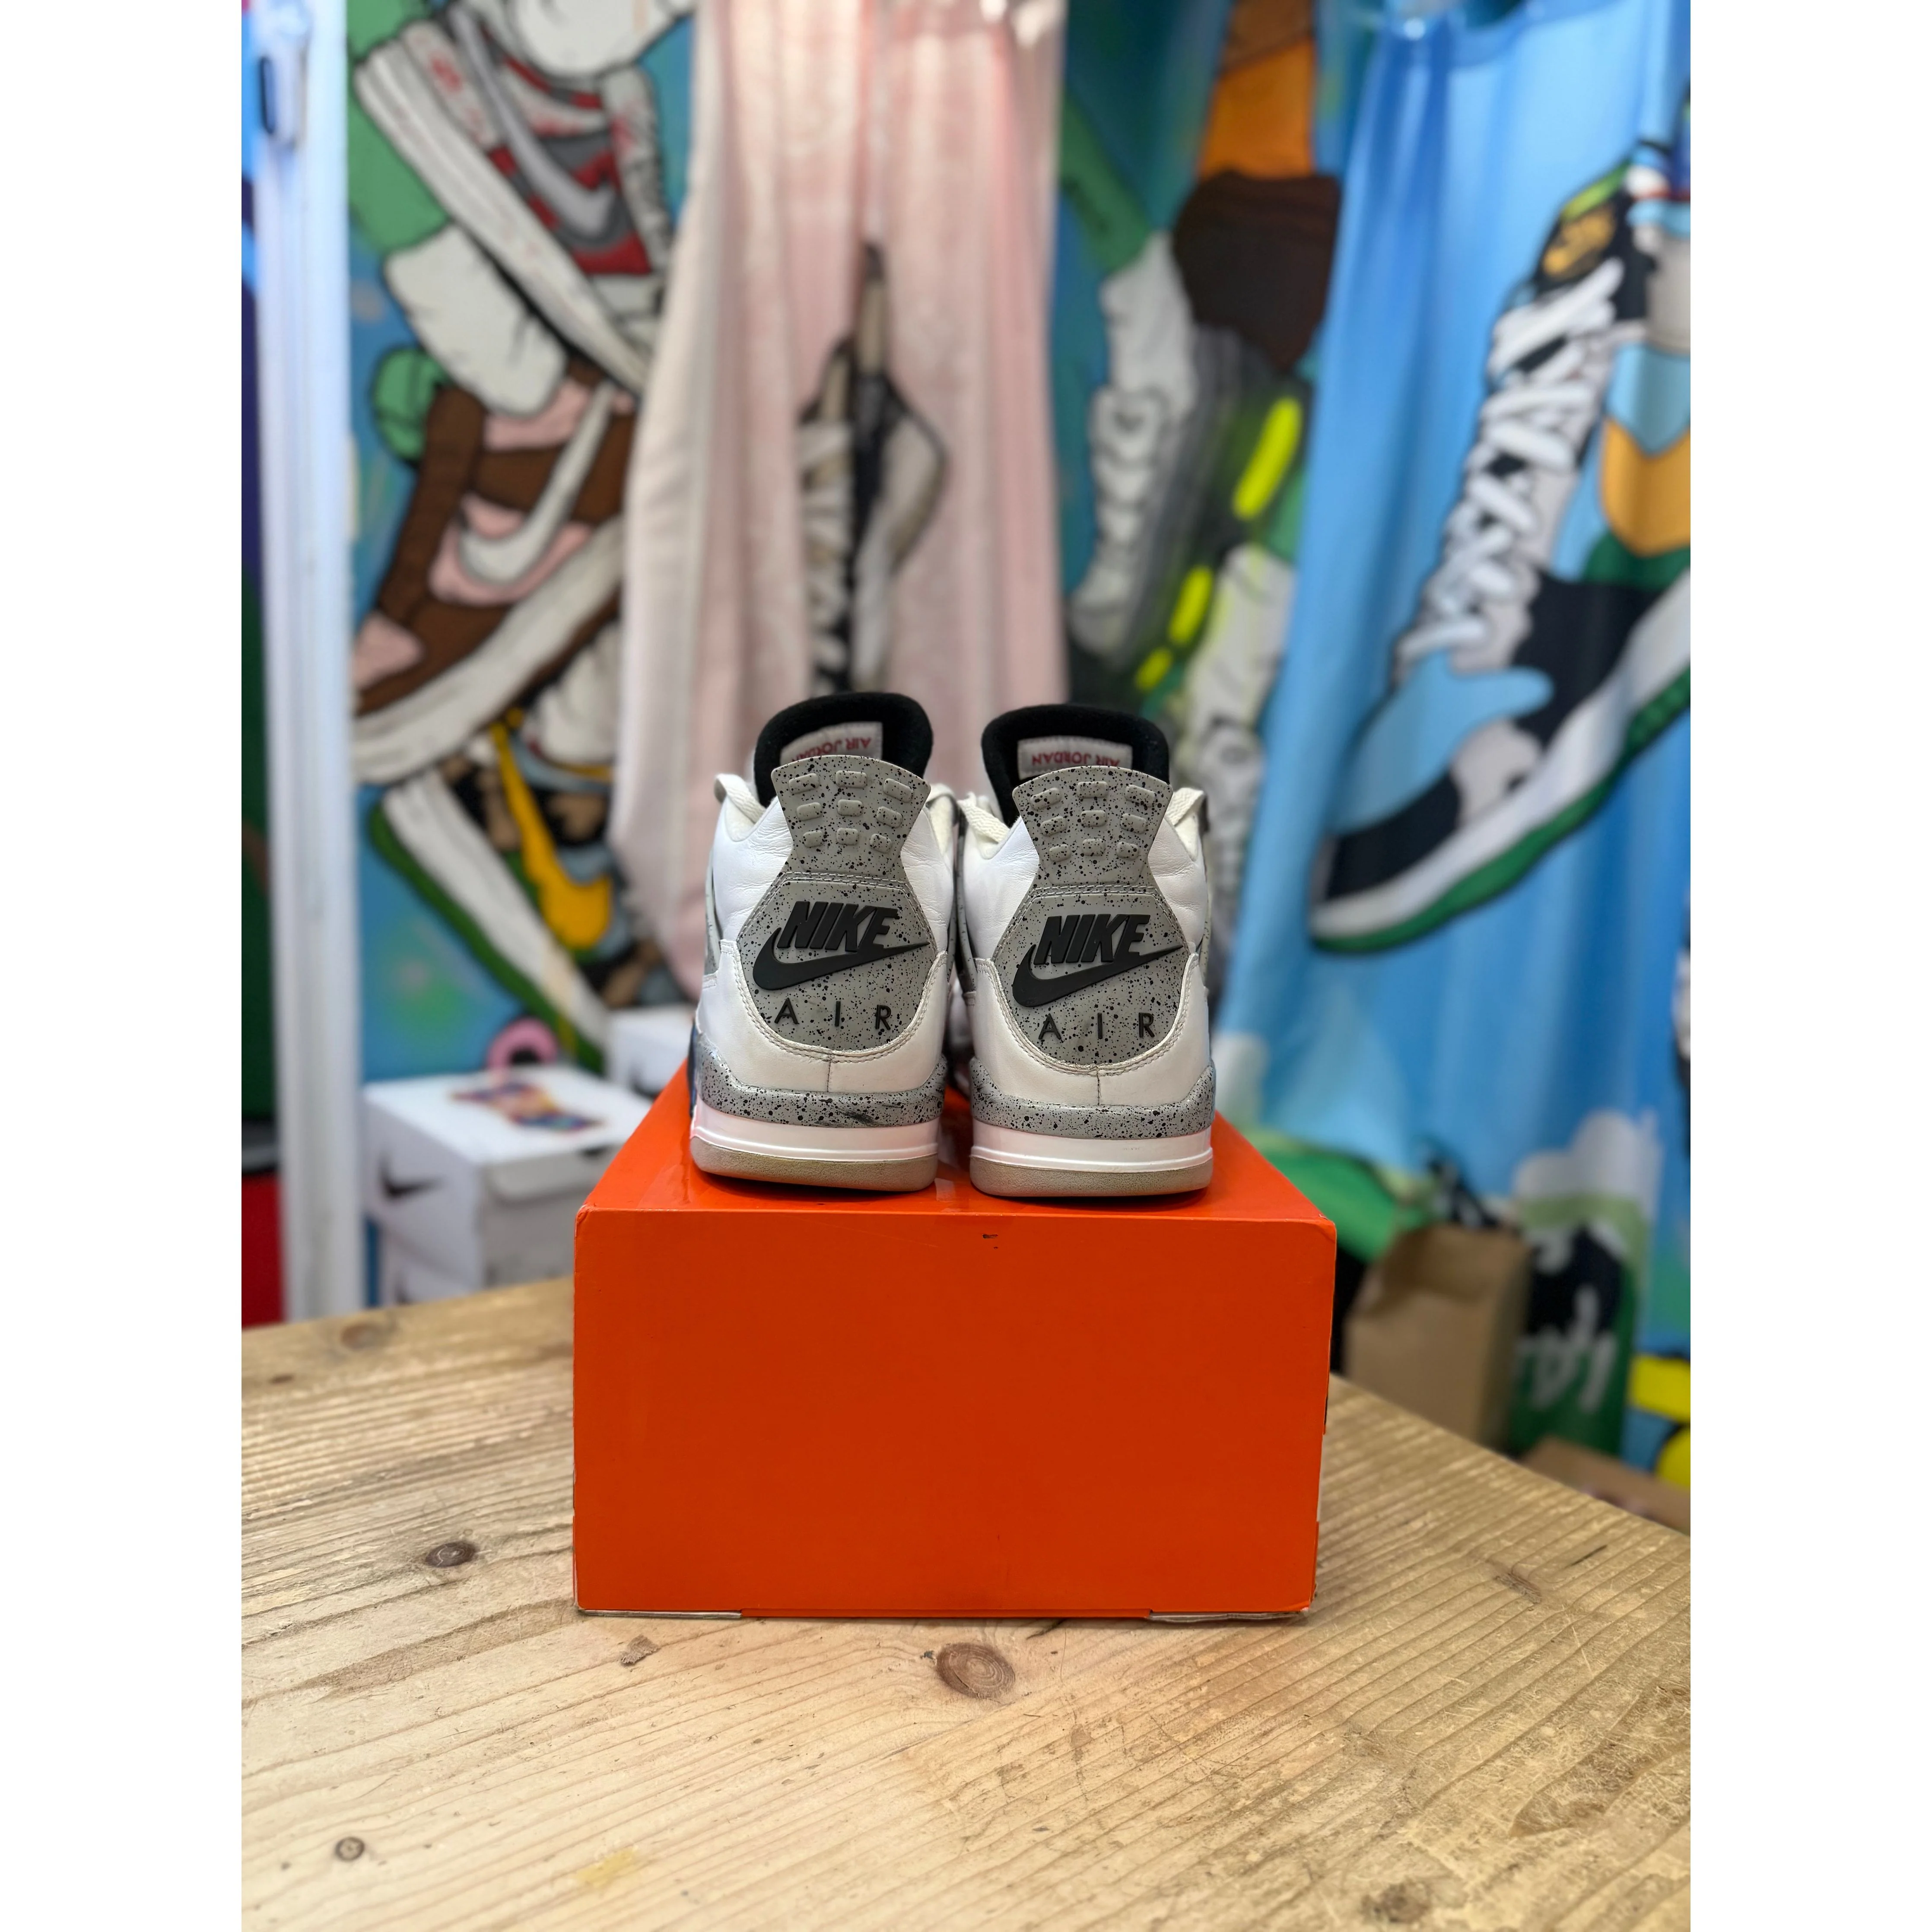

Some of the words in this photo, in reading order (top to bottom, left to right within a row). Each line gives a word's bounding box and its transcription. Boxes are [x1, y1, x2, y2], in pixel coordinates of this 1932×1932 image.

[845, 737, 872, 750] AIR
[1032, 750, 1092, 766] JORDAN
[1096, 753, 1120, 766] AIR
[777, 901, 898, 952] NIKE
[1033, 914, 1150, 964] NIKE
[774, 997, 892, 1030] AIR
[1038, 1012, 1155, 1040] AIR
